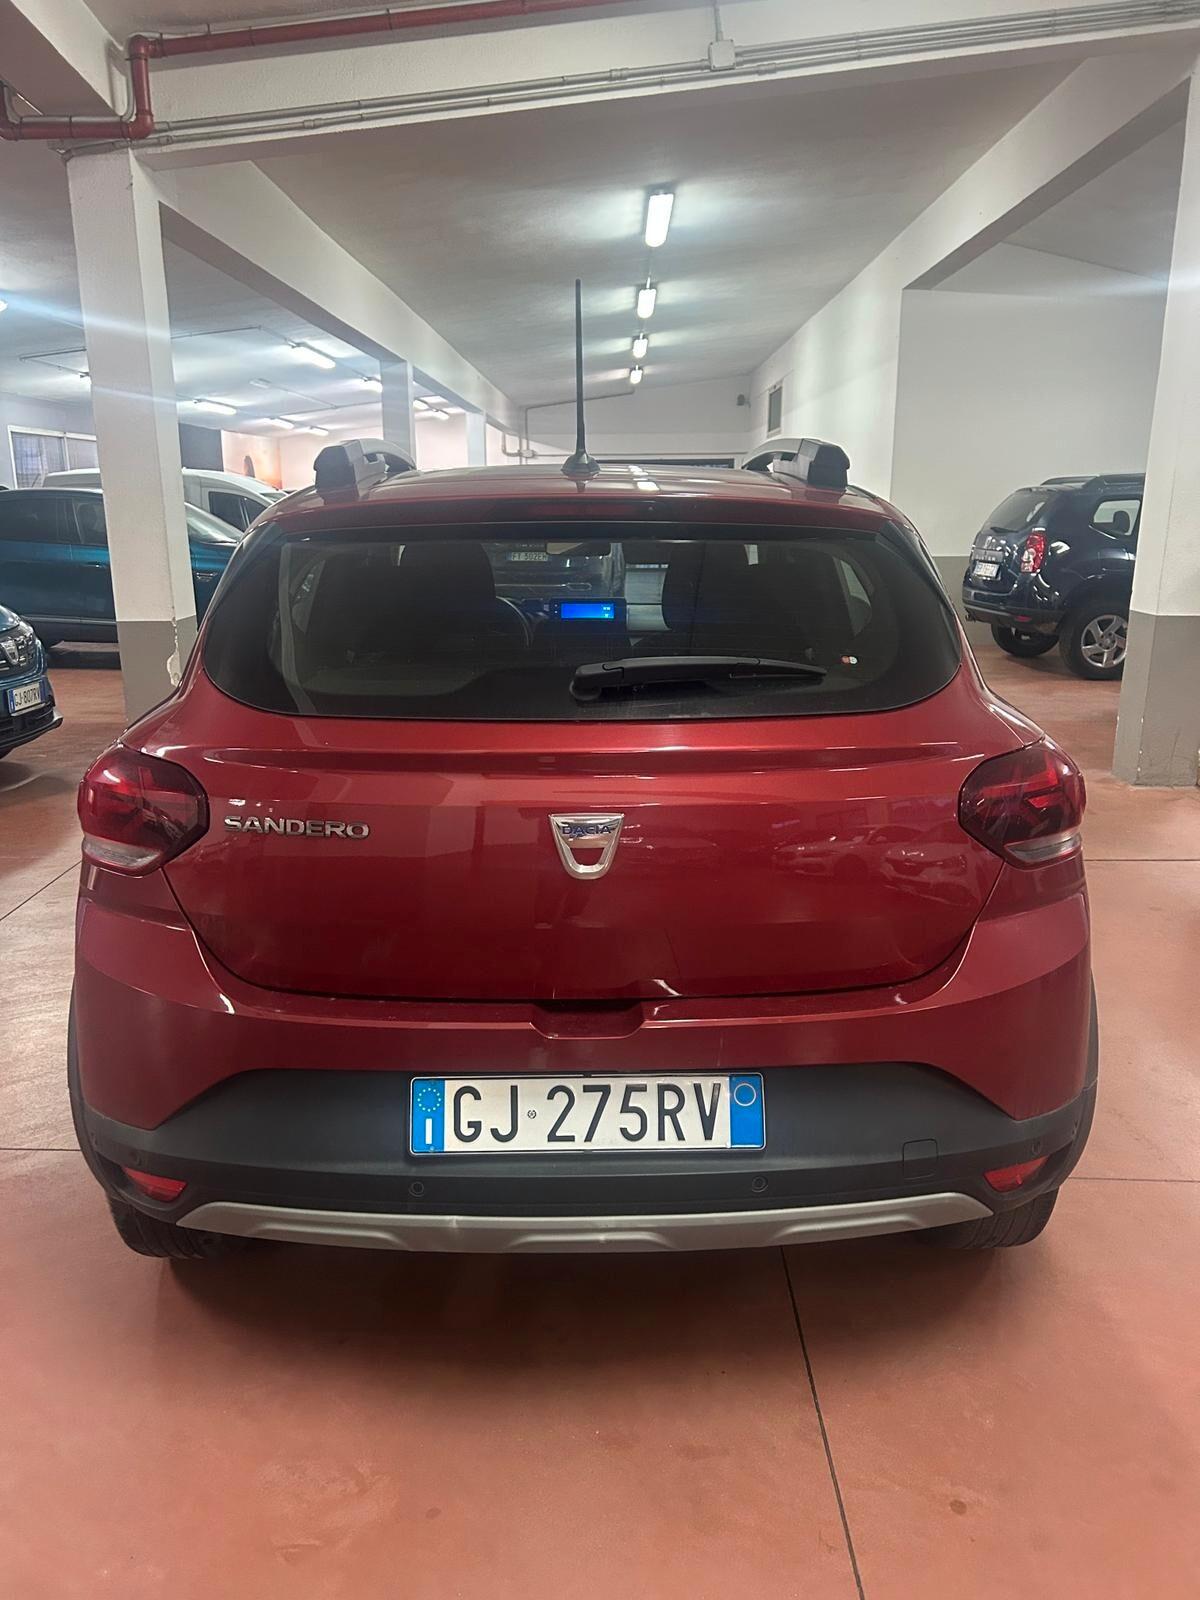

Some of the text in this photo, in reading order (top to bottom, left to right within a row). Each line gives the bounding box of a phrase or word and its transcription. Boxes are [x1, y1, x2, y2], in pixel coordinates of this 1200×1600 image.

[224, 815, 370, 840] SANDERO
[562, 825, 612, 835] DACIA
[453, 1082, 722, 1143] GJ 275RV
